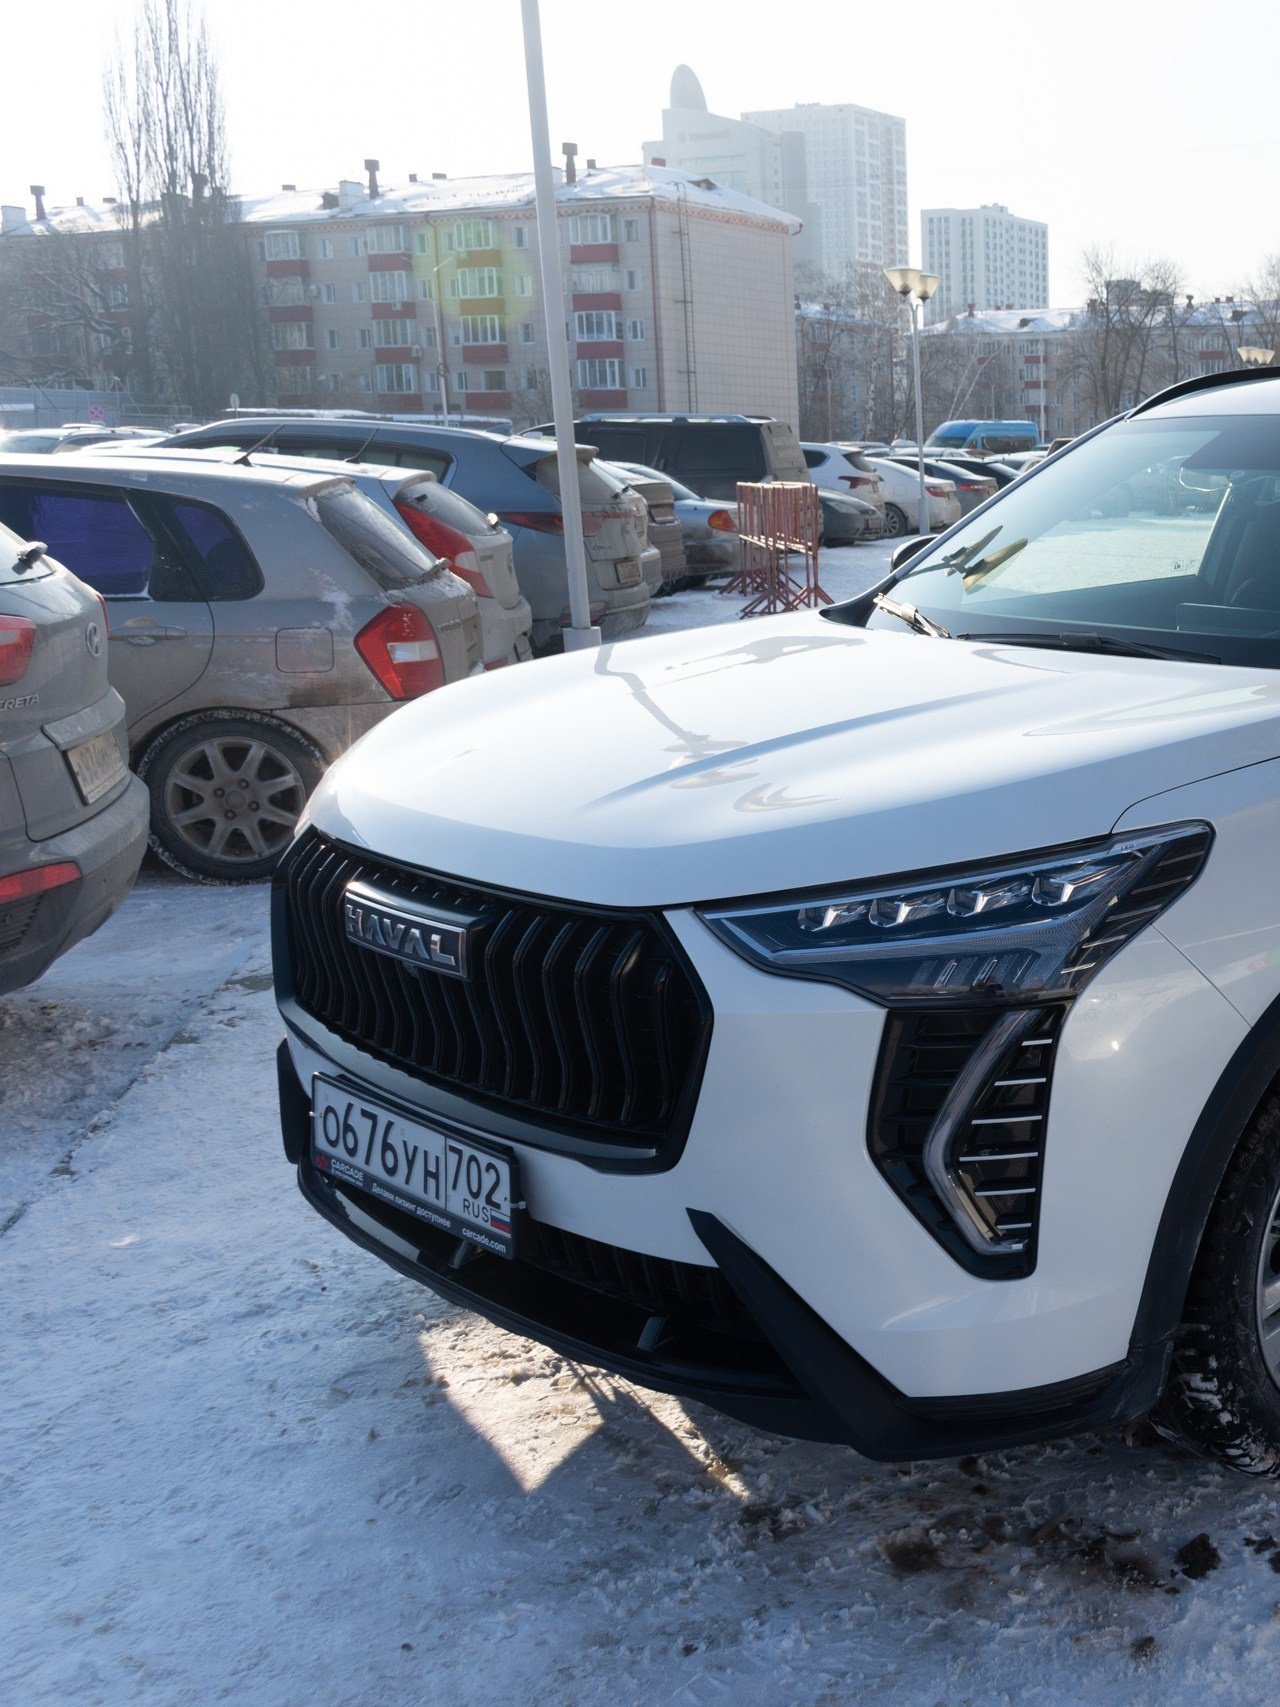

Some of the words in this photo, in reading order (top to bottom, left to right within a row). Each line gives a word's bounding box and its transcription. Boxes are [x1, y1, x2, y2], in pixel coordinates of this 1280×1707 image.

[345, 903, 456, 966] HAVAL
[330, 1158, 364, 1182] CARCADE
[448, 1143, 502, 1210] 702
[463, 1197, 490, 1224] RUS
[462, 1227, 506, 1253] carcade.com
